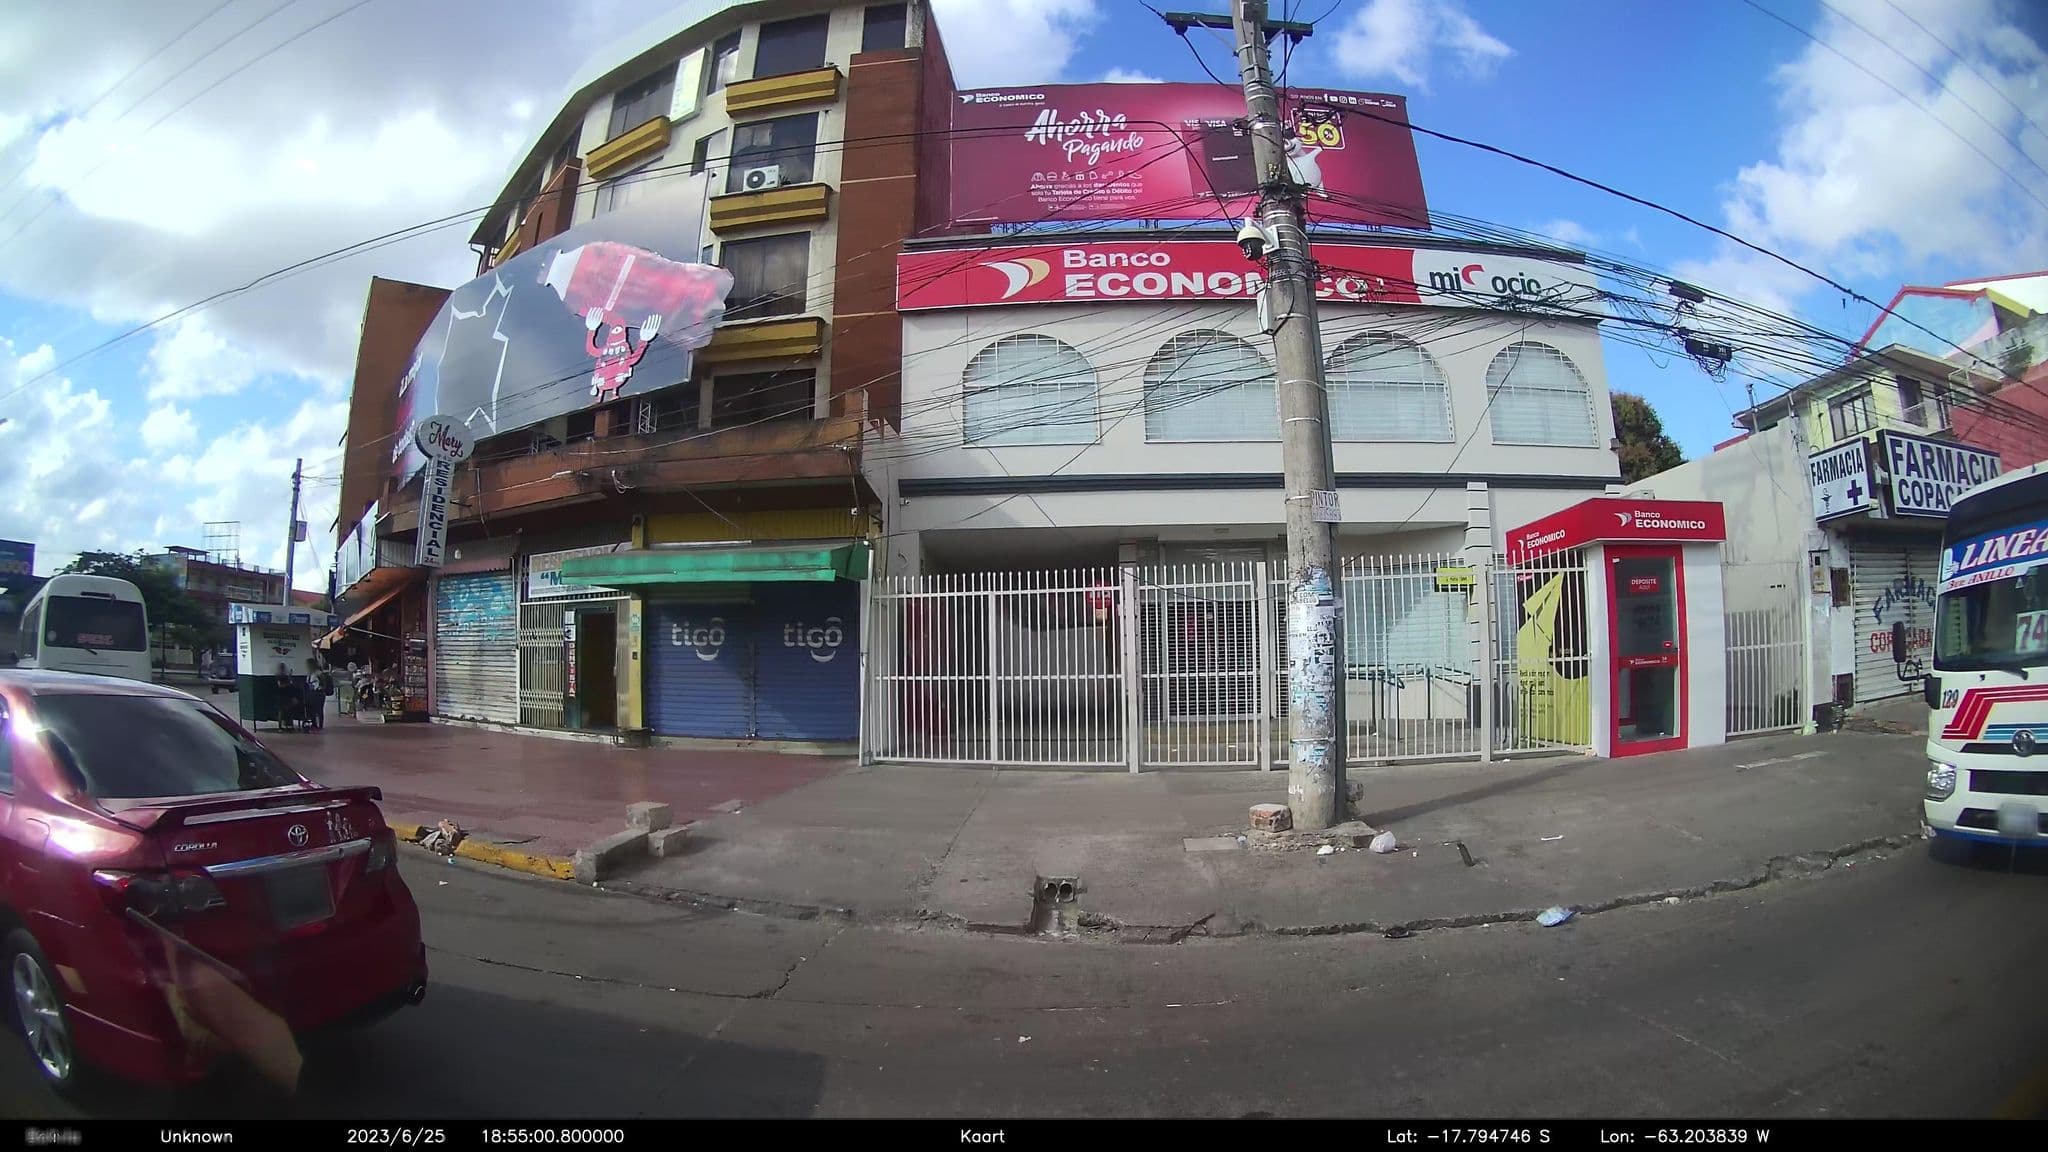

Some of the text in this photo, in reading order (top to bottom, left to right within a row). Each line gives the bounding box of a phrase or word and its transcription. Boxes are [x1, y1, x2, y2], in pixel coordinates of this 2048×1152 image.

[976, 94, 1045, 103] ECONOMICO
[1024, 109, 1128, 145] Ahorra
[1184, 119, 1200, 128] VIS
[1207, 120, 1227, 128] VISA
[1063, 132, 1144, 165] Pagando
[1063, 249, 1171, 268] Banco
[1811, 447, 1864, 486] FARMACIA
[1890, 438, 1999, 486] FARMACIA
[1311, 491, 1340, 508] PINTOR
[1898, 477, 1970, 510] COPAC
[426, 460, 450, 558] RESIDENCIAL
[1634, 510, 1661, 519] Banco
[1635, 519, 1706, 530] ECONOMICO
[1526, 531, 1540, 541] Banco
[1527, 529, 1565, 549] ECONOMICO
[1967, 566, 2016, 585] ANILLO
[1942, 689, 1959, 709] 129
[174, 842, 218, 852] COROLLA
